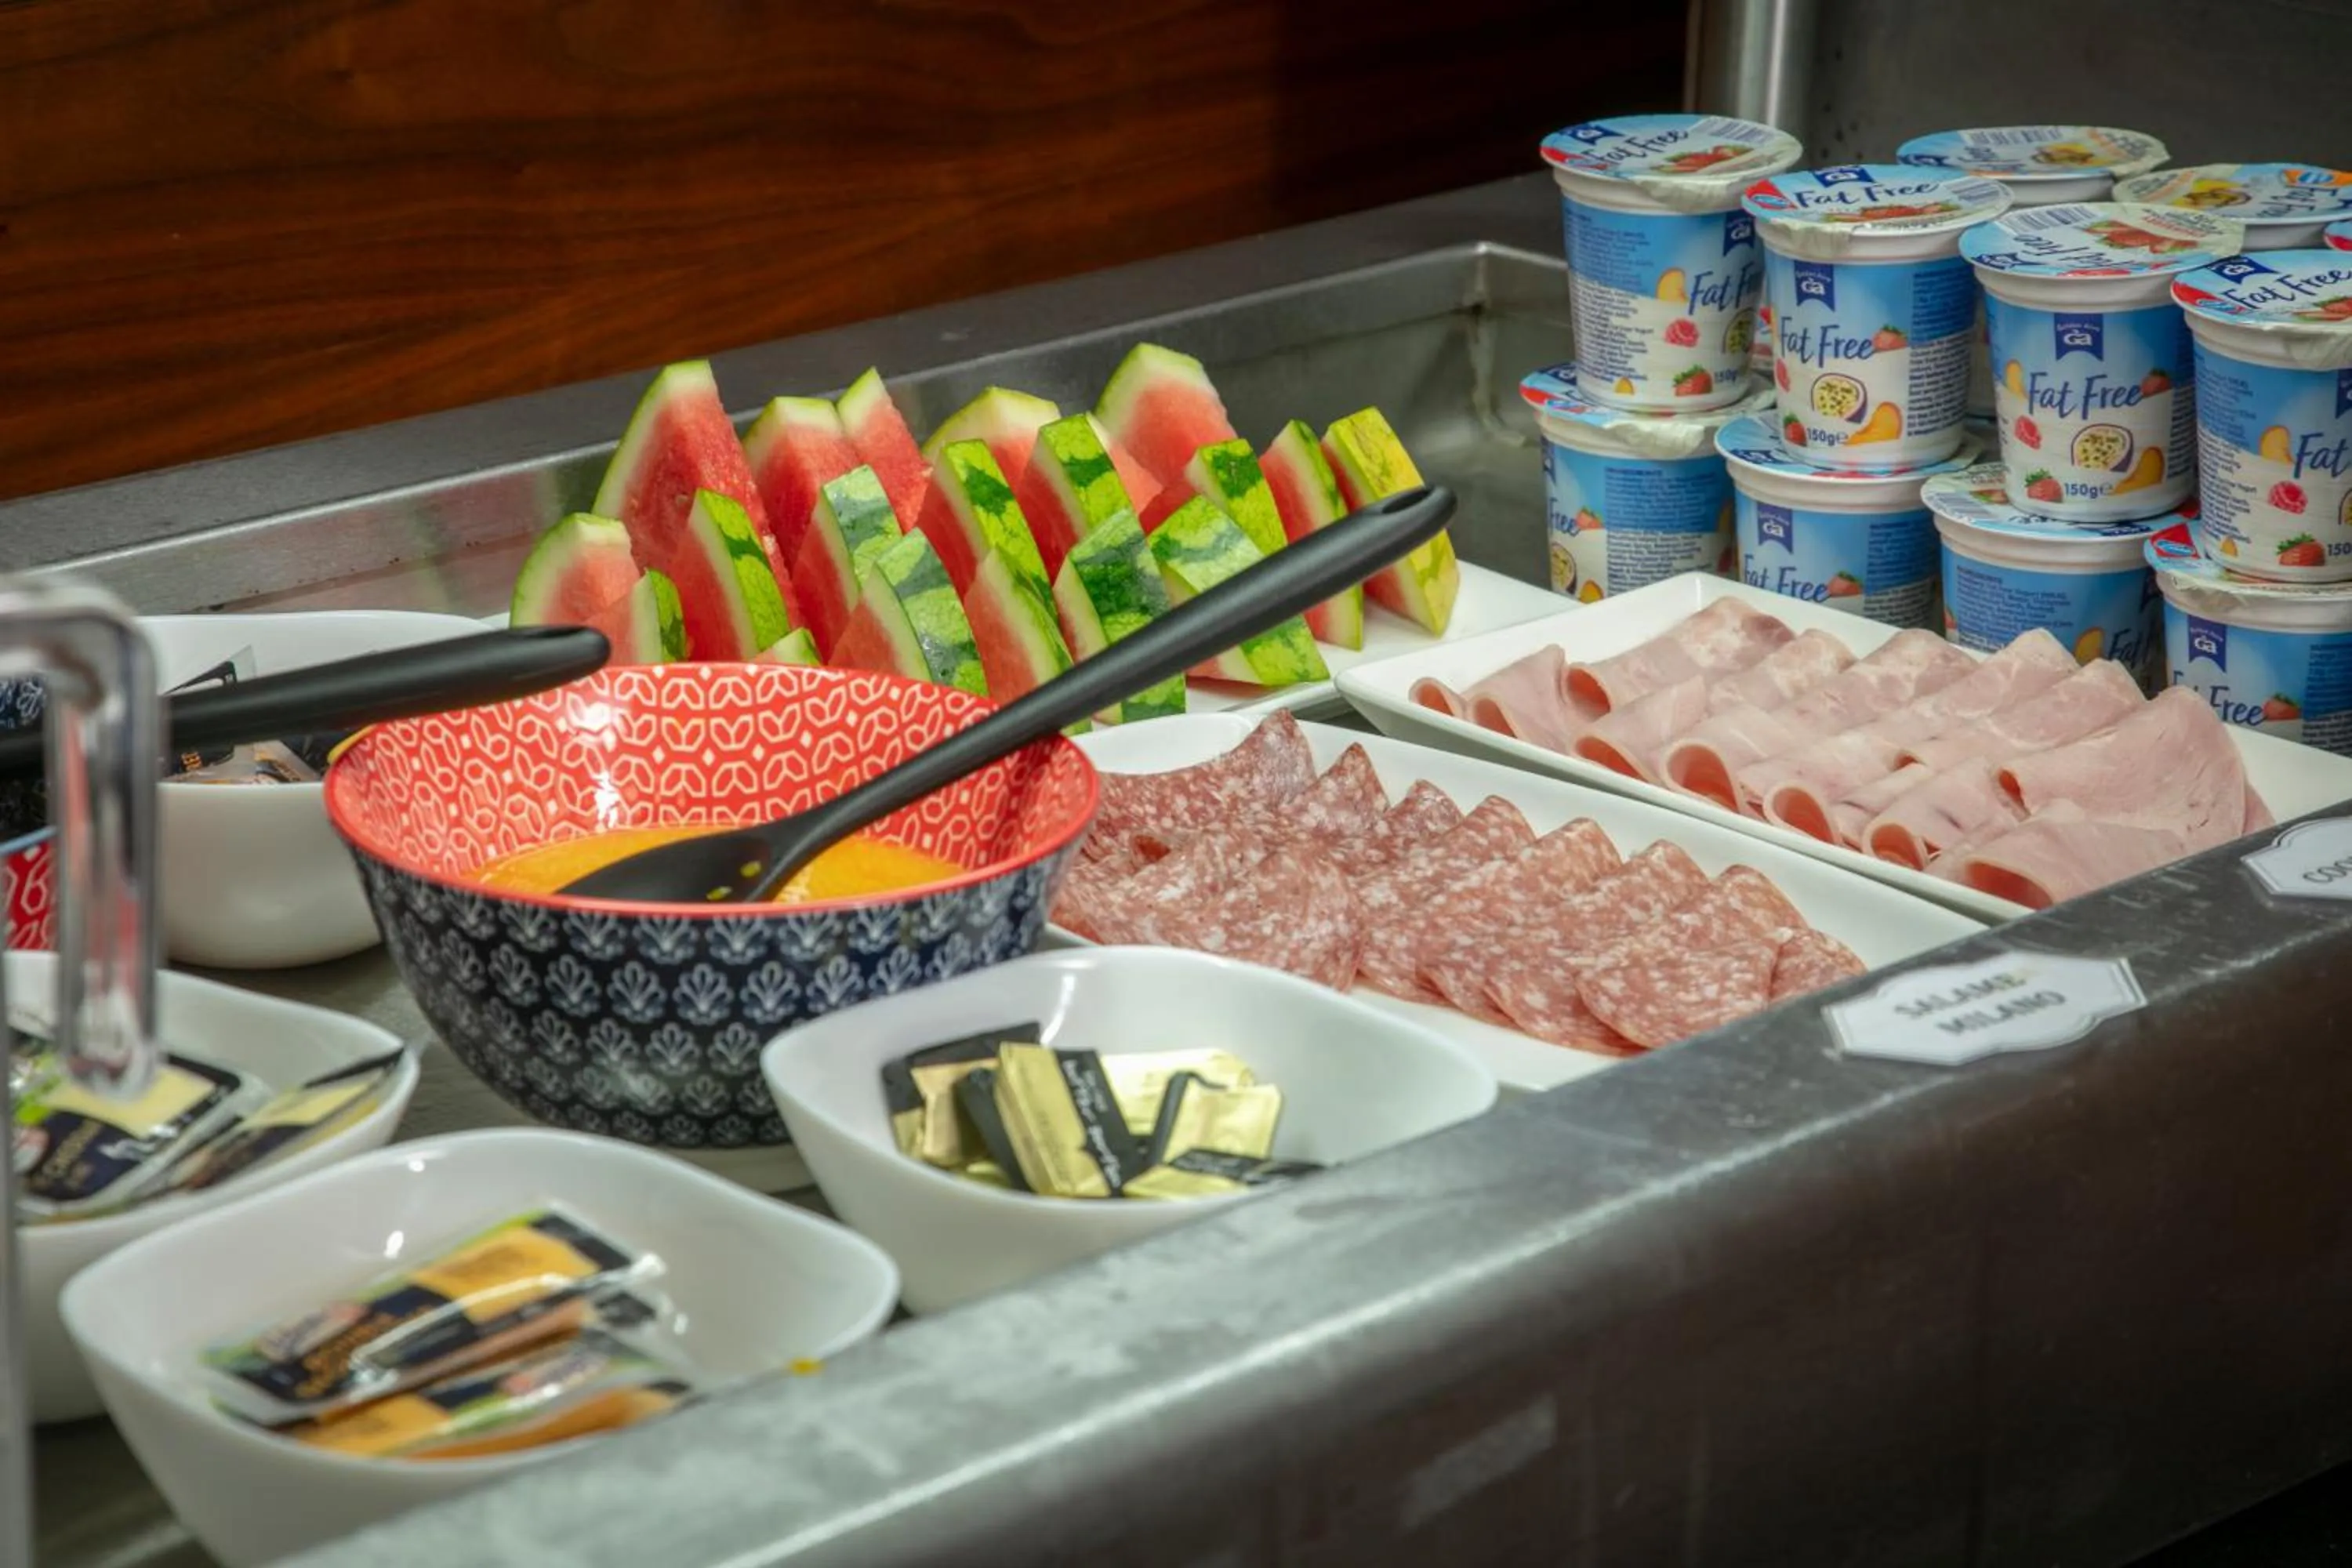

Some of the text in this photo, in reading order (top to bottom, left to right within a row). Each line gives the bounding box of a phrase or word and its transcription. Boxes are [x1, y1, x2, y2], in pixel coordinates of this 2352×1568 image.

[1582, 129, 1690, 165] Fat Free
[1794, 190, 1860, 208] Fat
[1864, 183, 1940, 201] Free
[1688, 270, 1735, 315] Fat
[2220, 286, 2296, 310] Fat
[2275, 267, 2352, 296] Free
[1780, 316, 1876, 368] Fat Free
[2029, 371, 2077, 419] Fat
[2082, 375, 2145, 421] Free
[1806, 427, 1836, 447] 150g
[2294, 432, 2352, 480] Fat
[2063, 482, 2099, 499] 150g
[1548, 497, 1581, 538] Free
[2327, 542, 2352, 557] 150
[1744, 553, 1769, 588] Fat
[1777, 566, 1832, 603] Free
[2209, 685, 2269, 727] Free
[2302, 855, 2352, 884] COO
[1935, 989, 2067, 1036] MILANO
